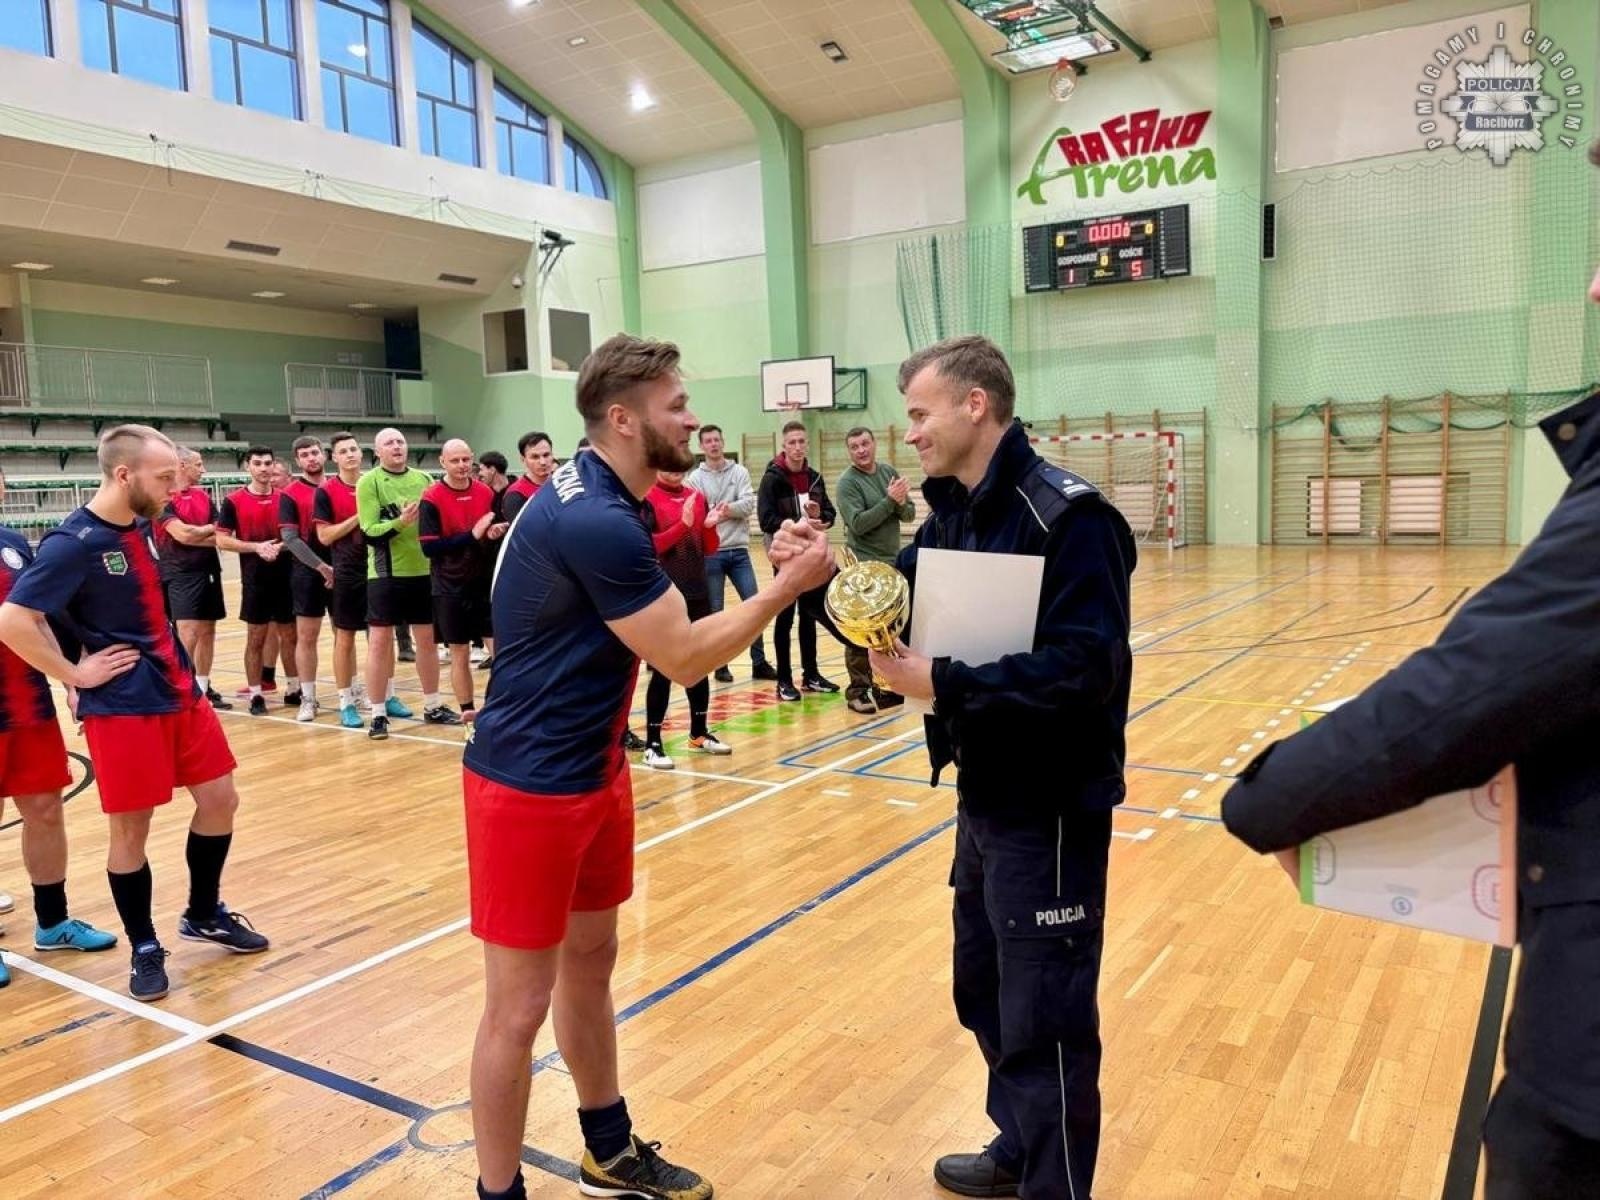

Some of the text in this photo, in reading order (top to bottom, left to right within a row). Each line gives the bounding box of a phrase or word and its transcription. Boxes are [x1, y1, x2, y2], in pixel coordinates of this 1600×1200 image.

[1017, 127, 1216, 205] Arena
[1057, 108, 1212, 167] RAFAKO
[1035, 904, 1086, 926] POLICJA
